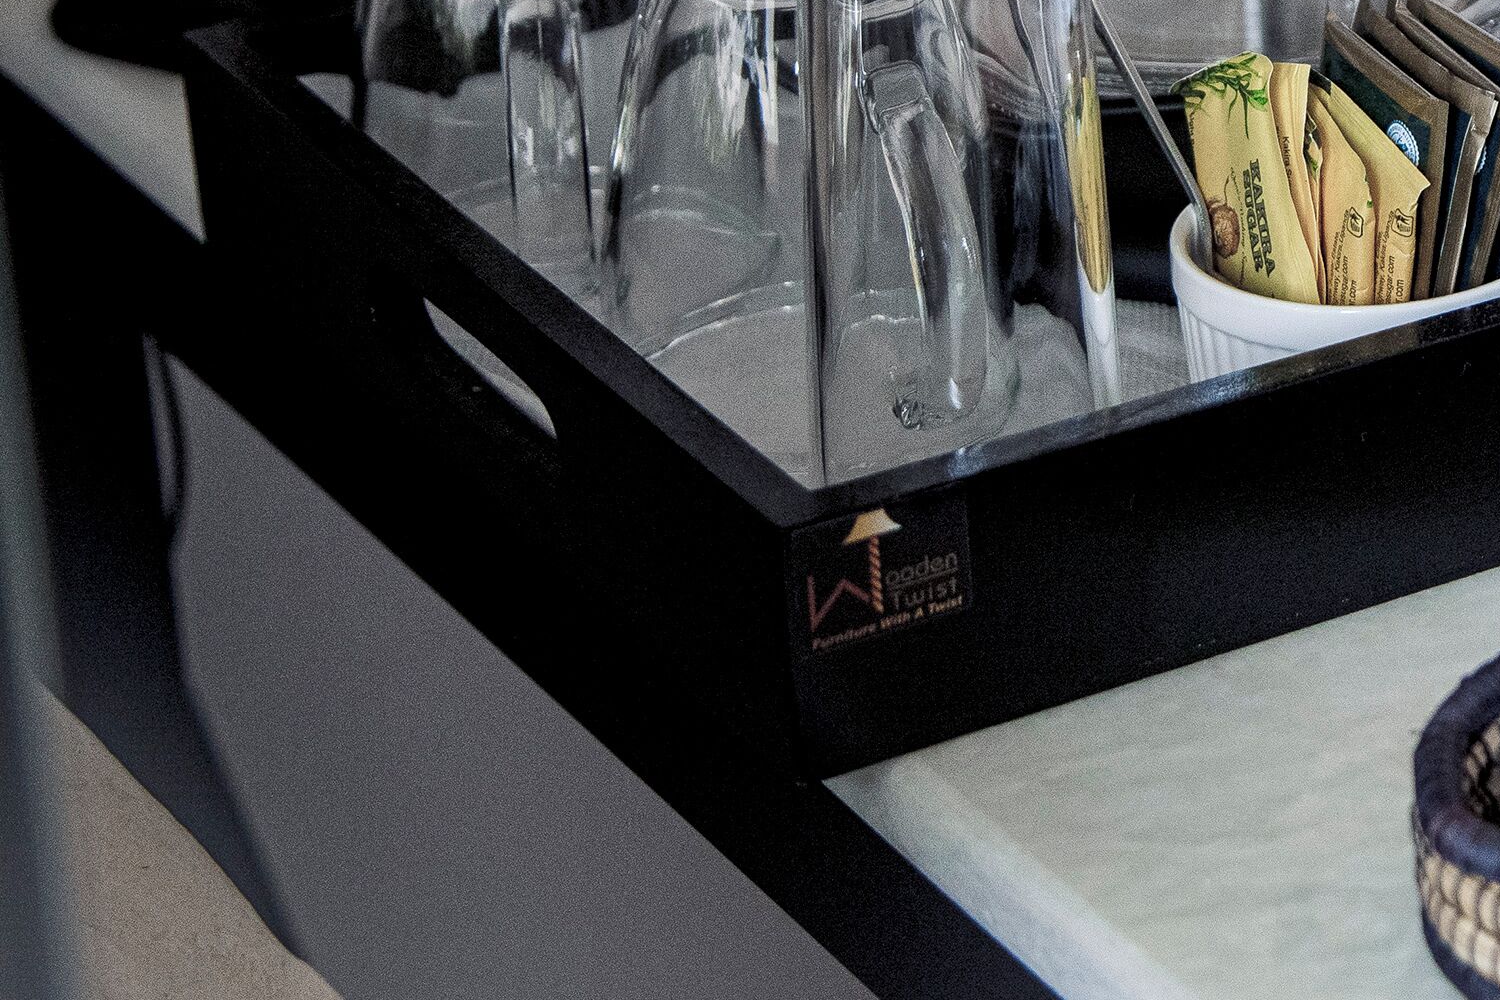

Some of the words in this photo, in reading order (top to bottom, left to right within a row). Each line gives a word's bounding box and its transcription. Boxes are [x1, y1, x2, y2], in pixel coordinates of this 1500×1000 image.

[1282, 136, 1292, 166] Kakira
[1242, 168, 1264, 273] SUGAR
[1249, 158, 1276, 278] KAKIRA
